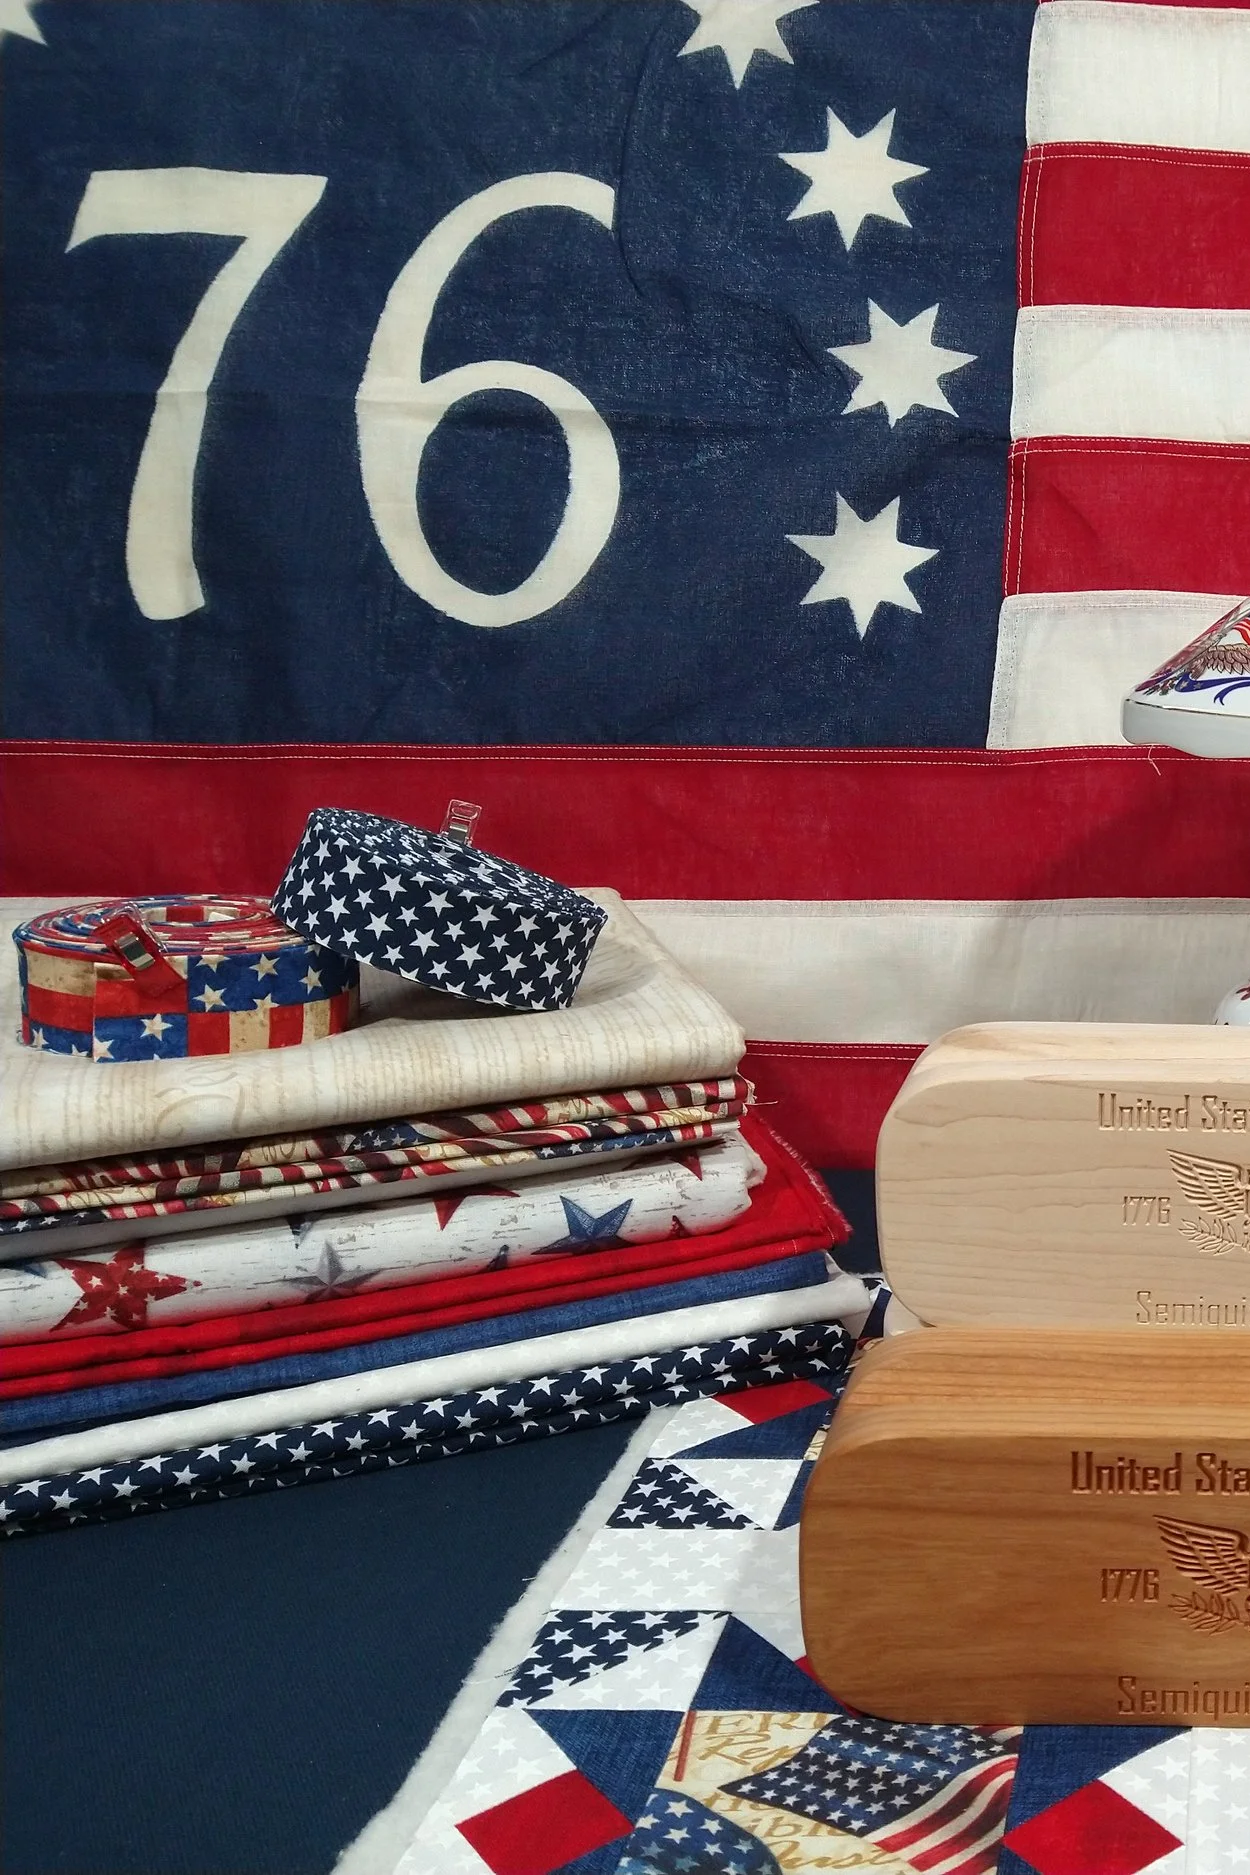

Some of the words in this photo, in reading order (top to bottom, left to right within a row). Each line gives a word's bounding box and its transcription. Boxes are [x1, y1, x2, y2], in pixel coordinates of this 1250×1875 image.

[65, 167, 620, 628] 76
[1098, 1092, 1190, 1132] United
[1122, 1195, 1171, 1227] 1776
[1071, 1450, 1182, 1496] United
[1100, 1568, 1159, 1604] 1776
